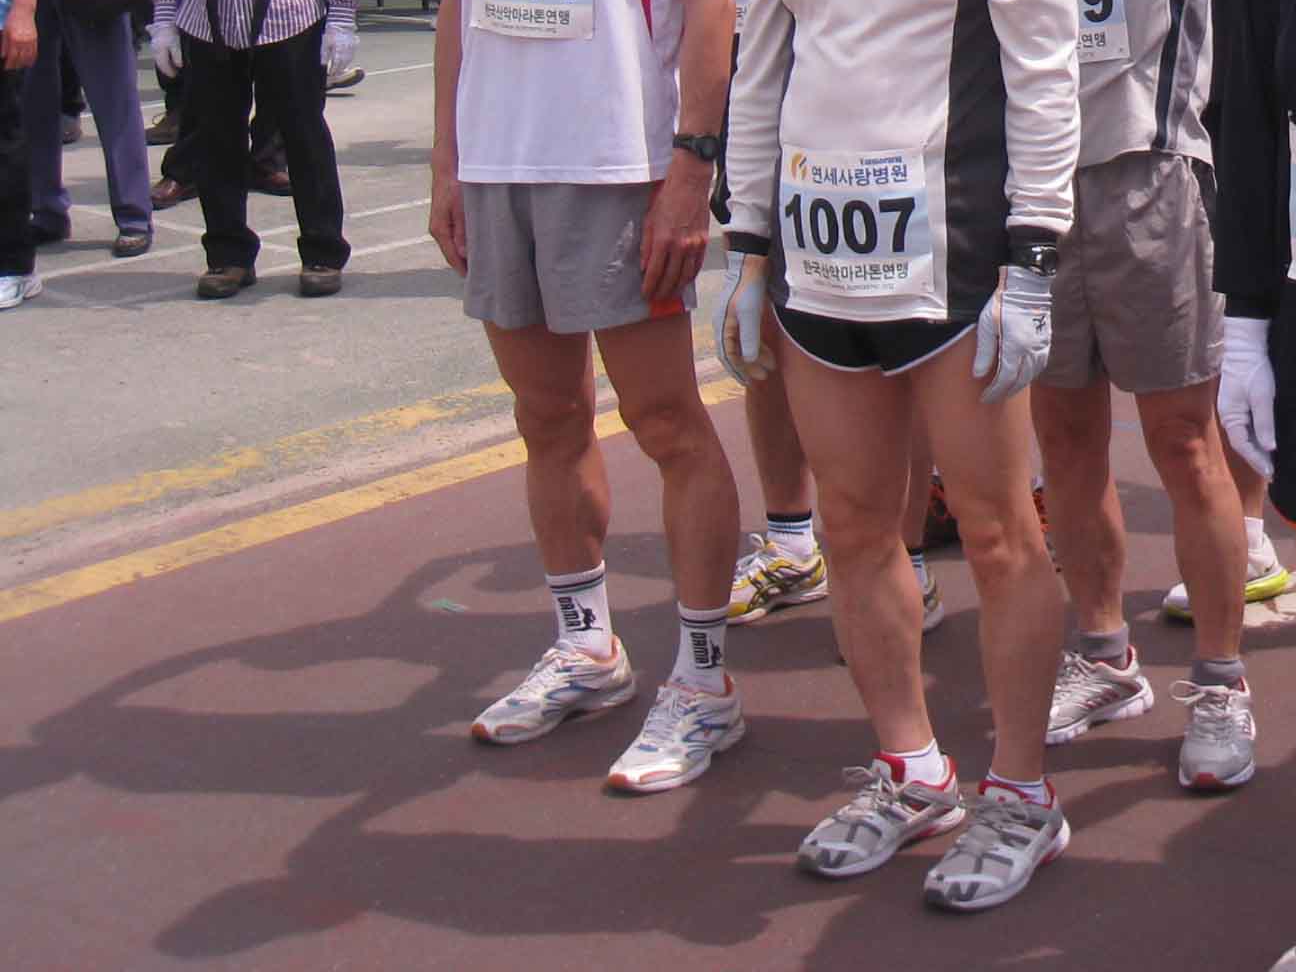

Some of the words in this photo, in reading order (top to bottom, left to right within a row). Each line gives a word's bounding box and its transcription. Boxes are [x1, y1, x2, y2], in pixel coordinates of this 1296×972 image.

[811, 164, 908, 187] 연세사랑병원
[784, 192, 916, 255] 1007
[802, 259, 909, 281] 한국산악마라톤연맹
